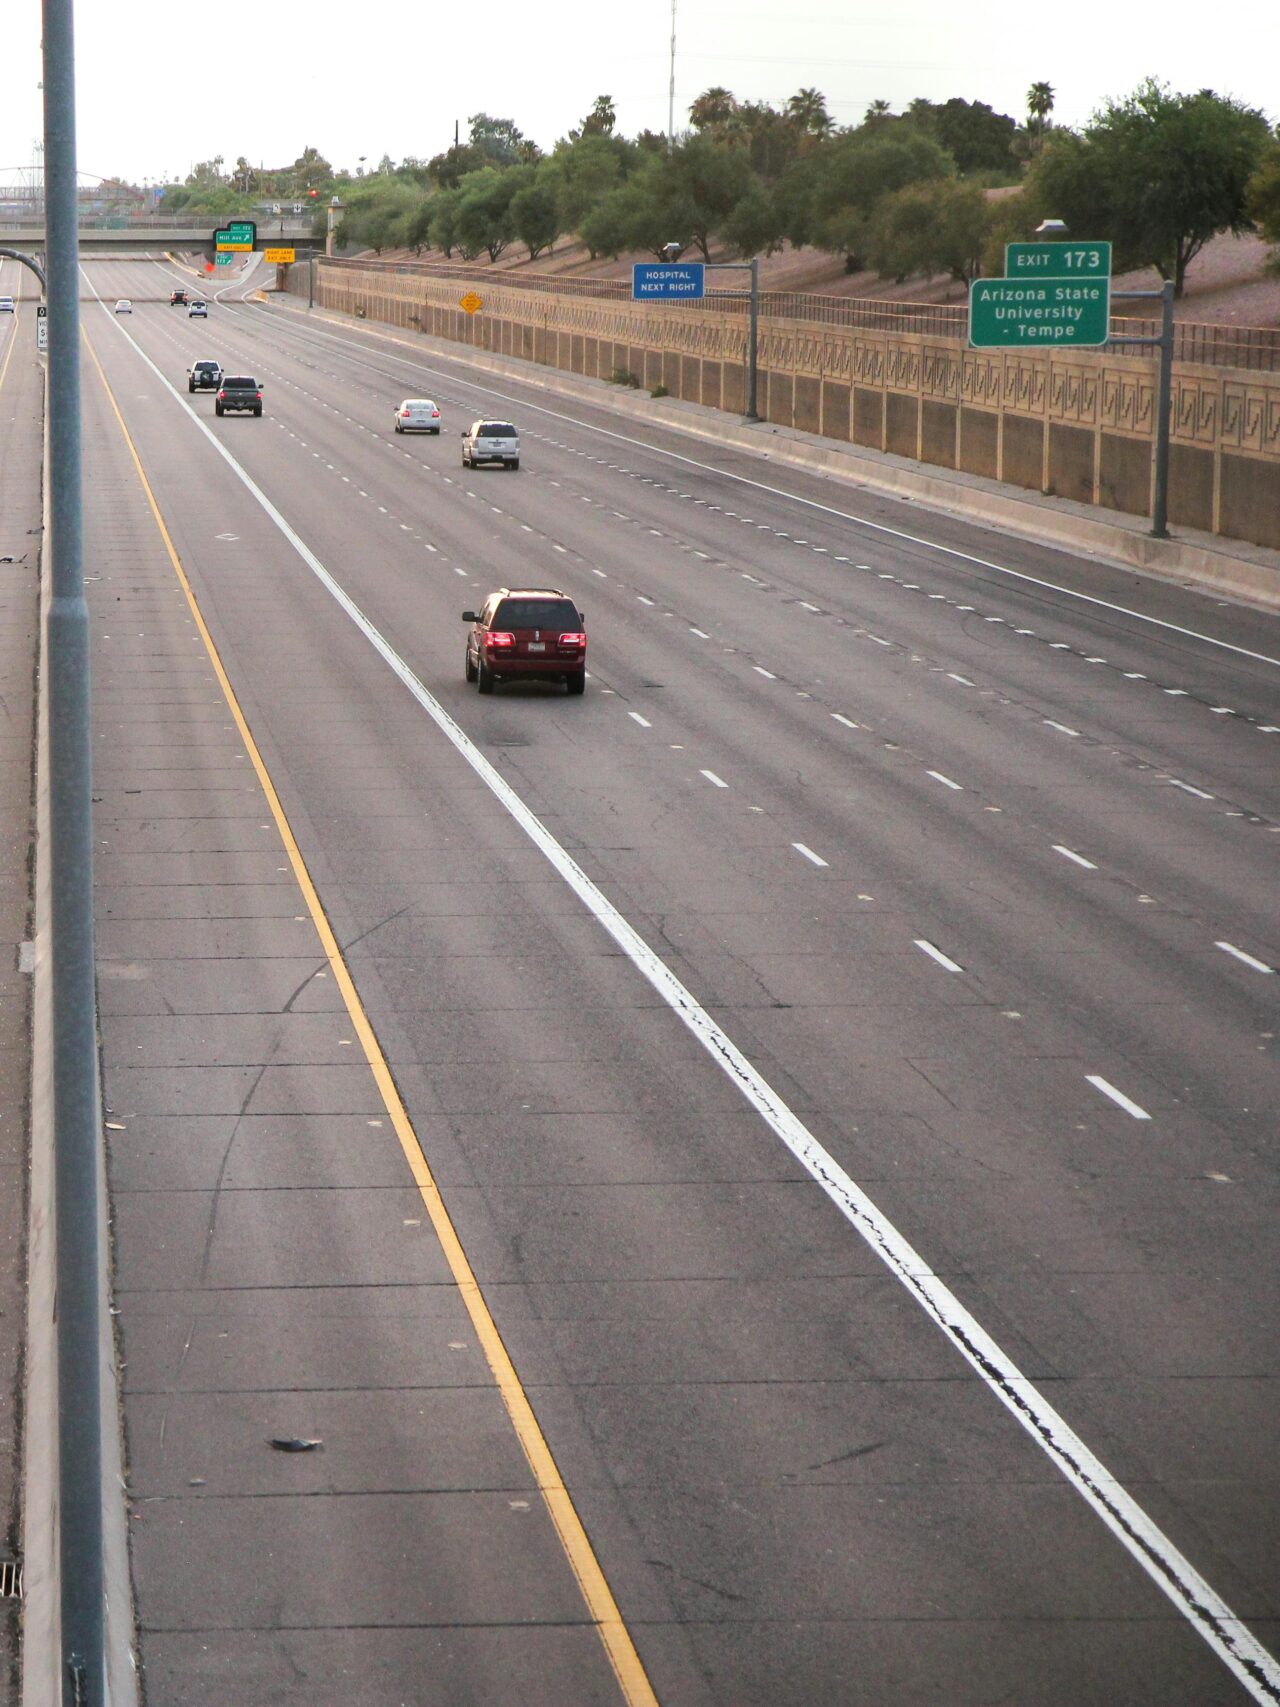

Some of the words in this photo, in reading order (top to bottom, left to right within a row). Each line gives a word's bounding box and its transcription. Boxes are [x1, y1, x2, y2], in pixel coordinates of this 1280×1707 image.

[1017, 254, 1051, 266] EXIT
[1063, 251, 1100, 268] 173
[646, 271, 691, 279] HOSPITAL
[641, 283, 665, 291] NEXT
[669, 283, 696, 291] RIGHT
[980, 288, 1047, 301] Arizona
[1055, 287, 1100, 300] State
[995, 305, 1083, 321] University
[1018, 324, 1075, 339] Tempe
